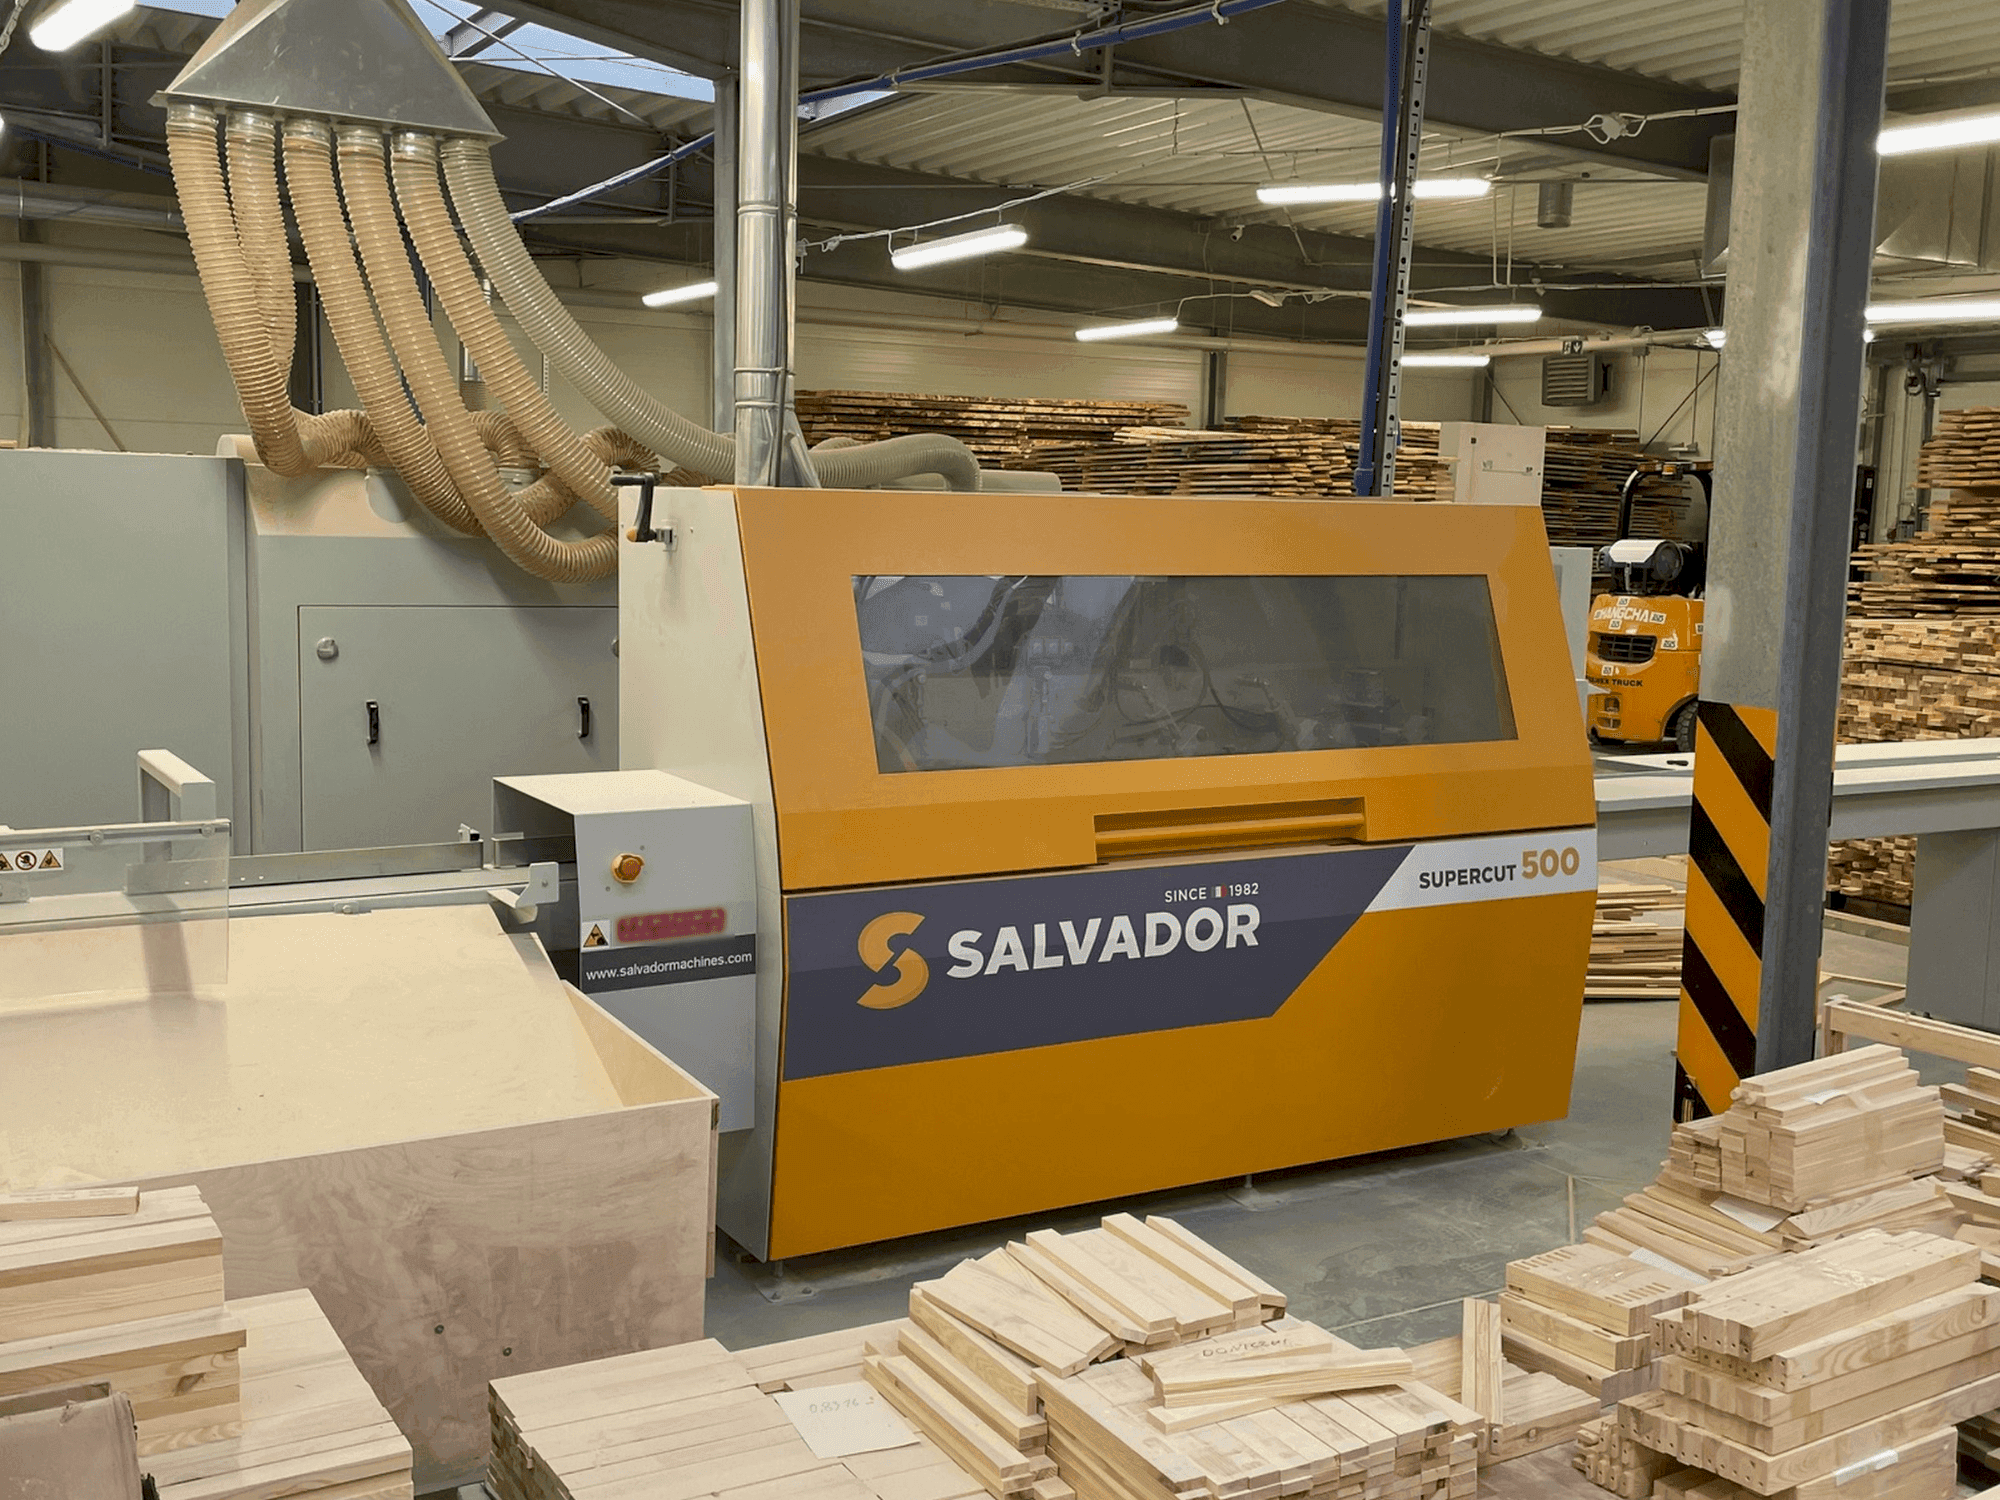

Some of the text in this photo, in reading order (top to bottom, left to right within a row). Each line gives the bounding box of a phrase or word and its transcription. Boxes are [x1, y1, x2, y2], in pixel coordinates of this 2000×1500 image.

[1612, 678, 1643, 687] TRUCK
[1419, 847, 1580, 889] SUPERCUT 500
[1164, 883, 1260, 902] SINCE 1982
[946, 903, 1261, 979] SALVADOR
[586, 952, 752, 980] www.salvadormachines.com
